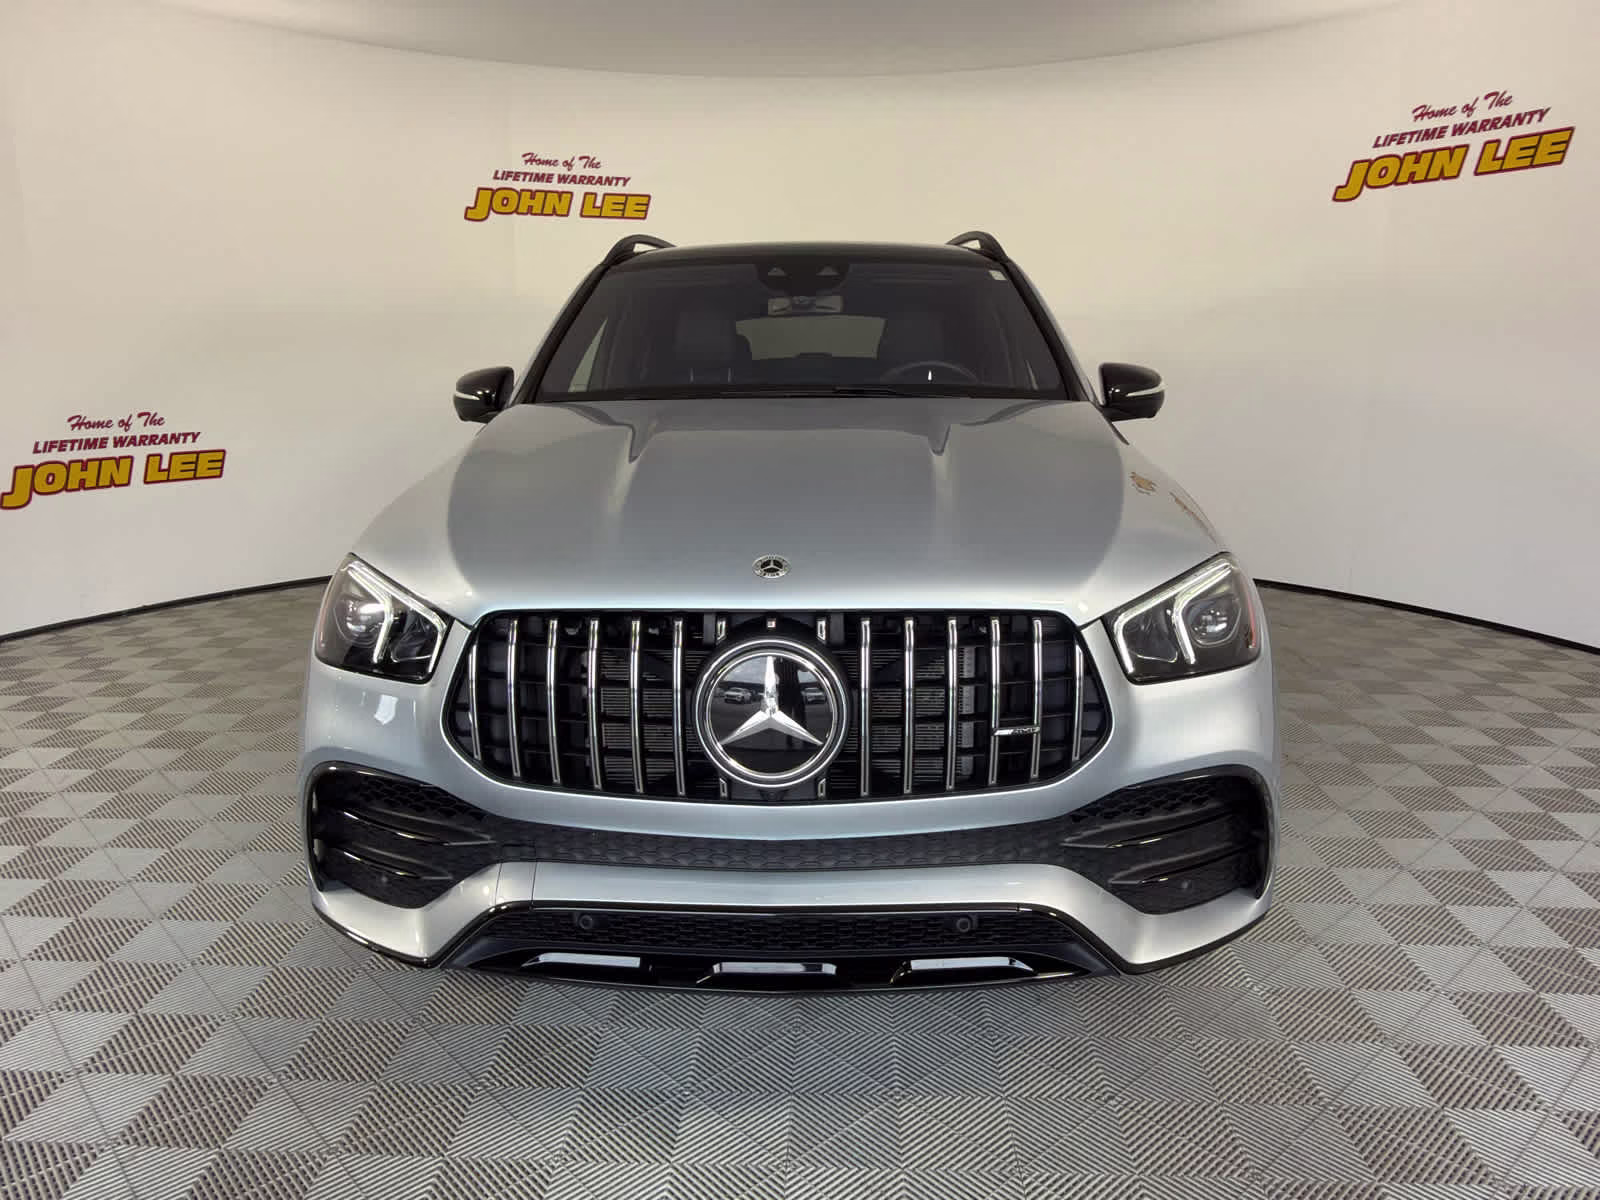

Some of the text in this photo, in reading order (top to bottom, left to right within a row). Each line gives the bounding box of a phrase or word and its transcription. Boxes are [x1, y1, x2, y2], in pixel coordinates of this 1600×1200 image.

[1412, 90, 1513, 122] Home of The
[1372, 107, 1551, 148] LIFETIME WARRANTY
[522, 152, 601, 171] Home of The
[1332, 126, 1575, 202] JOHN LEE
[493, 170, 631, 187] LIFETIME WARRANTY
[464, 187, 651, 222] JOHN LEE
[67, 412, 166, 432] Home of The
[32, 431, 201, 454] LIFETIME WARRANTY
[0, 449, 226, 510] JOHN LEE
